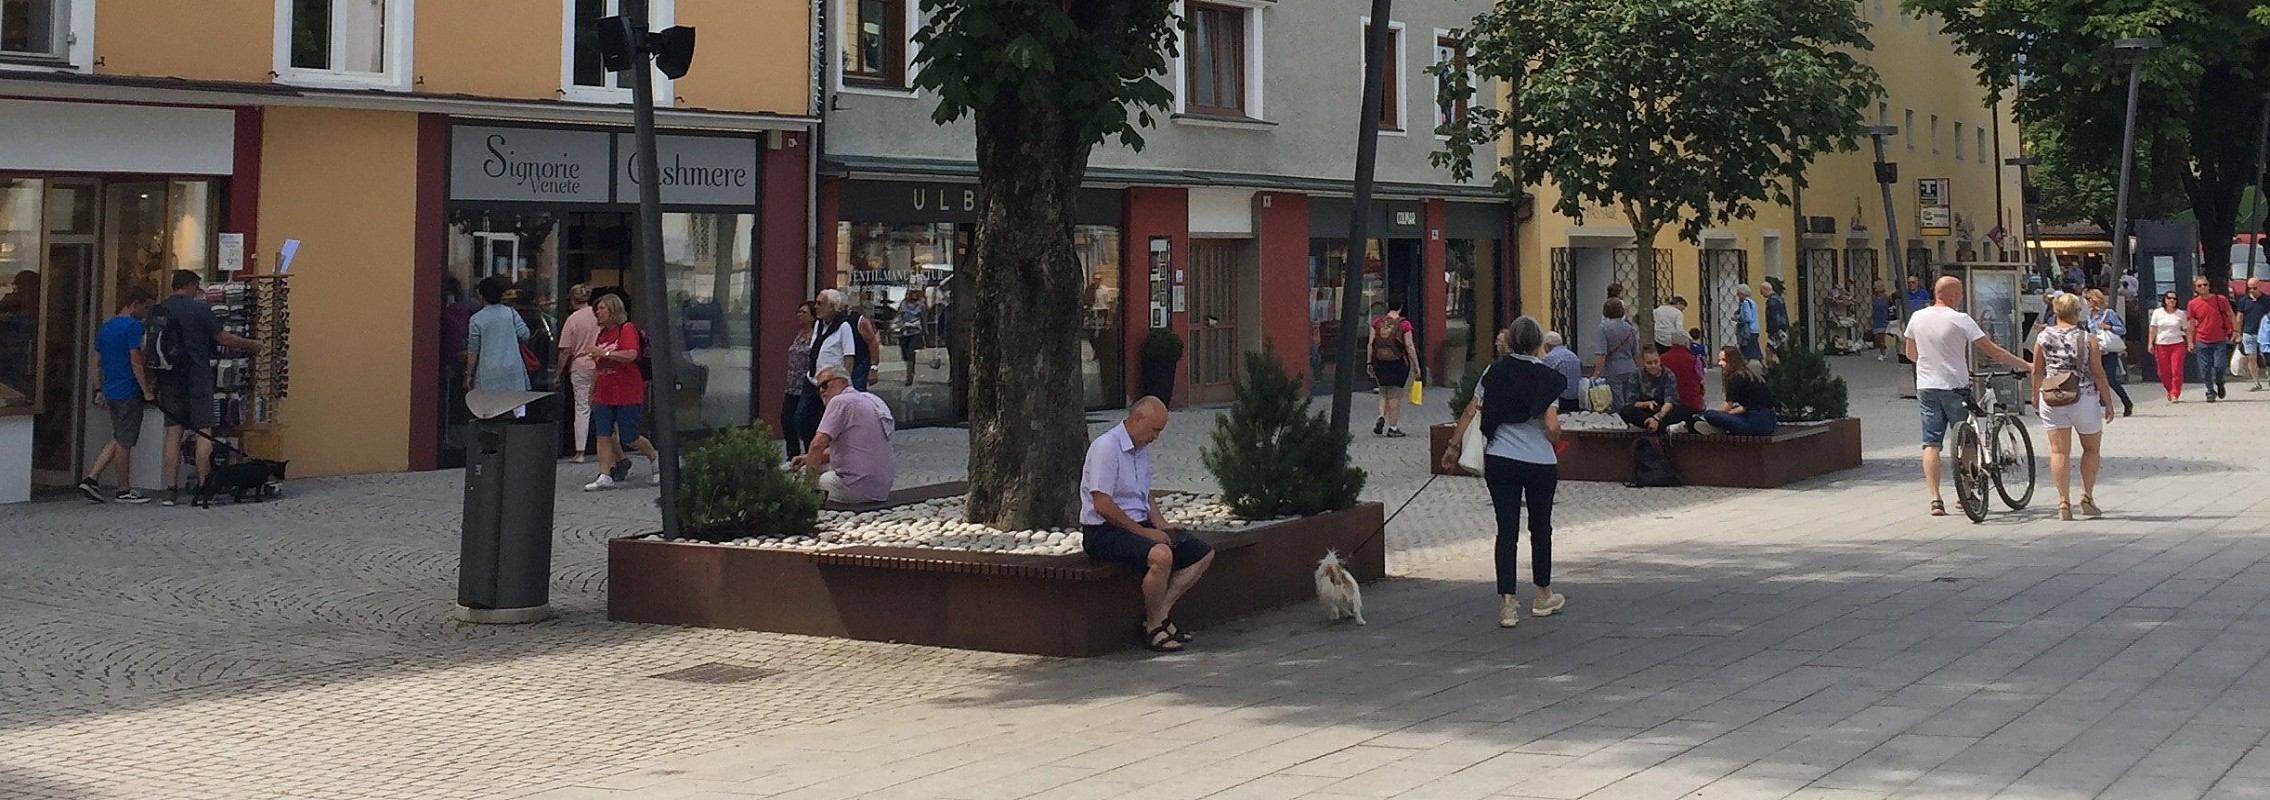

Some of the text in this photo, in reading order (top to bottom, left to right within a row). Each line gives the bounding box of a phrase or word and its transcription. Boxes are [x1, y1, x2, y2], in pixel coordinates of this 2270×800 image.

[483, 134, 580, 185] Signorie
[627, 152, 747, 188] Cshmere
[530, 177, 580, 194] Venete
